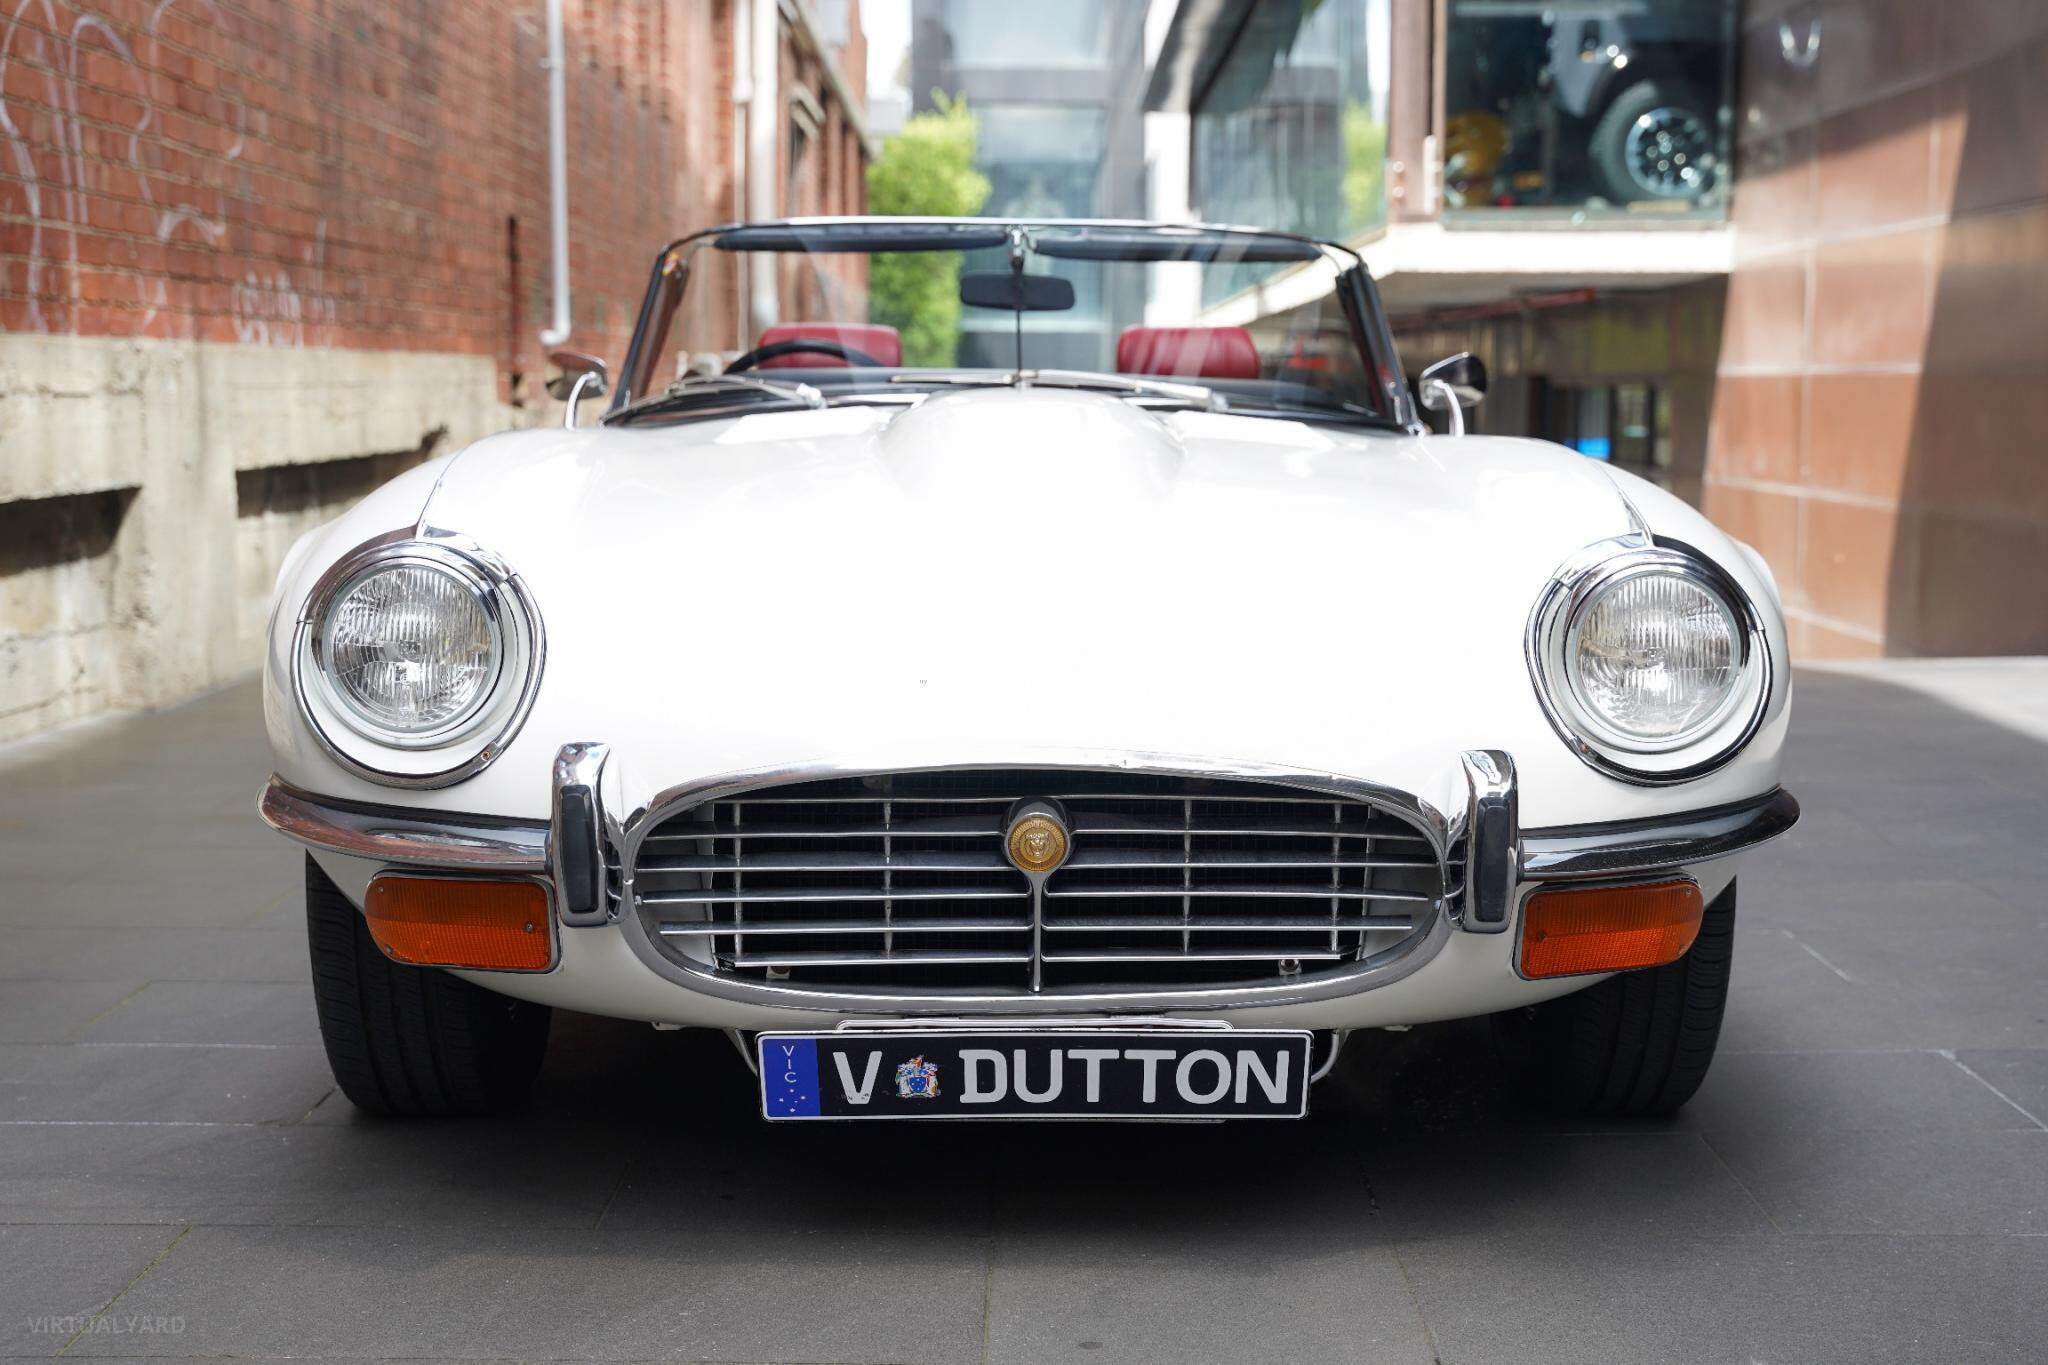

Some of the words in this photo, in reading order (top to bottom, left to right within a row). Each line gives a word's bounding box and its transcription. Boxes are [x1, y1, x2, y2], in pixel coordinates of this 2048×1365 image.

[782, 1045, 797, 1083] VIC
[833, 1051, 882, 1104] V
[958, 1049, 1288, 1104] DUTTON
